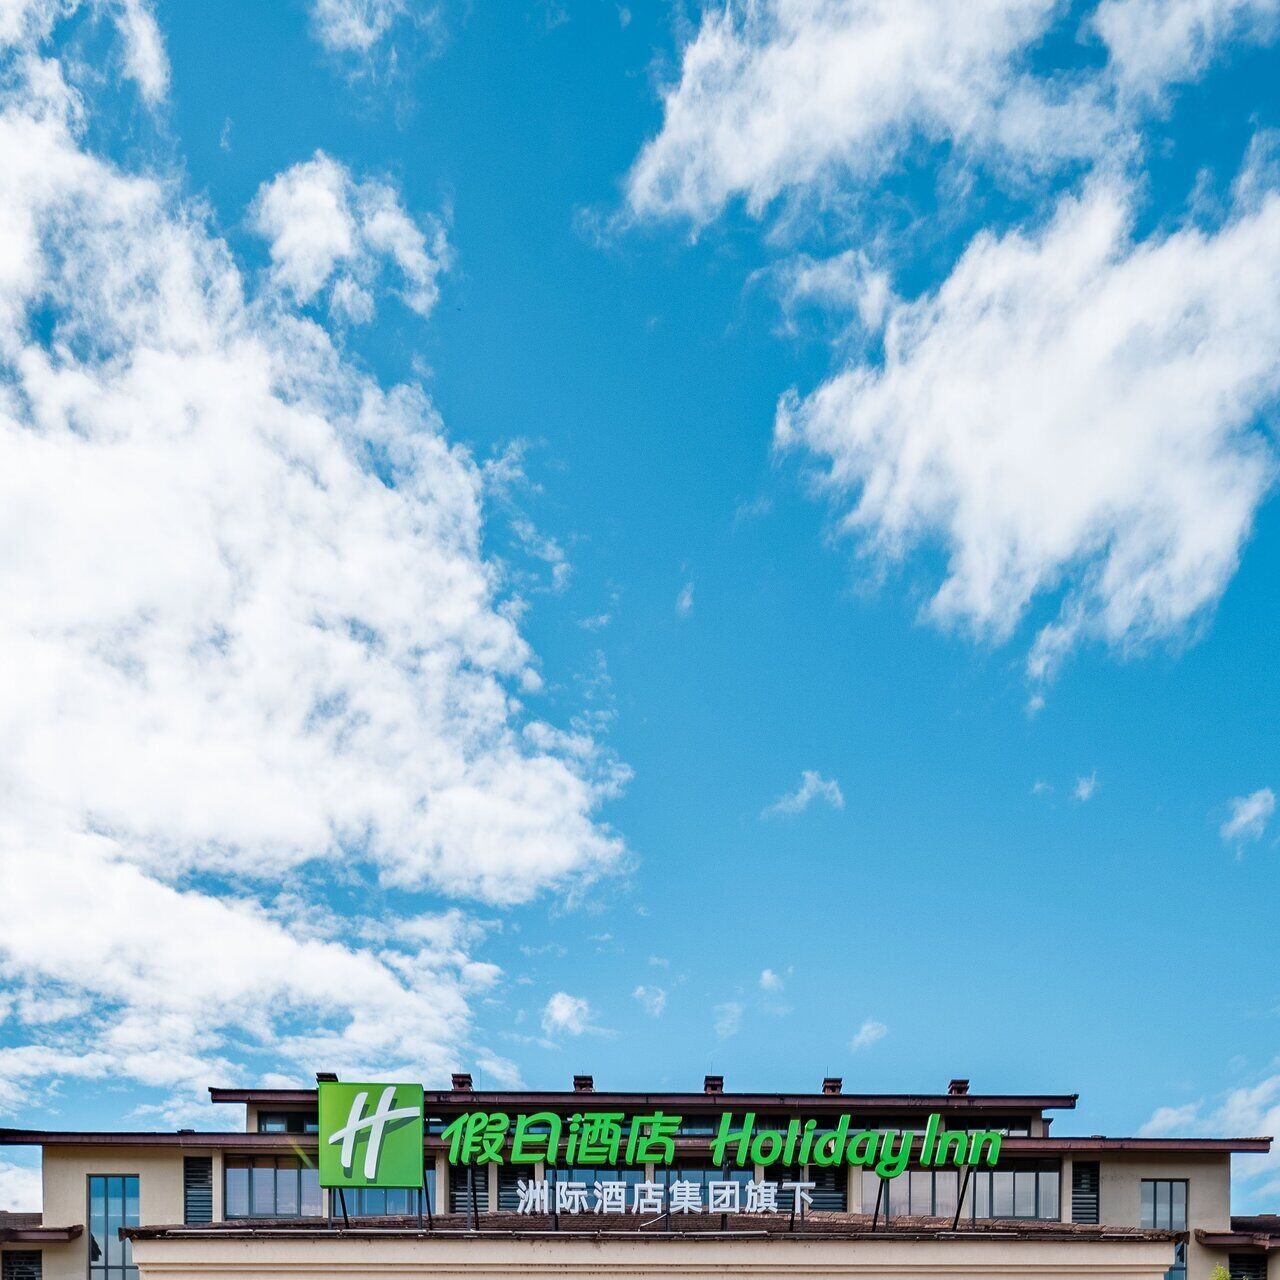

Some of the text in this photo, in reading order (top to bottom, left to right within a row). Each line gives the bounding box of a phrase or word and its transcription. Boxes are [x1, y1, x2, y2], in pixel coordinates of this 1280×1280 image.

[440, 1111, 683, 1166] 假日酒店
[710, 1112, 1004, 1180] Holiday Inn
[516, 1179, 817, 1215] 洲际酒店集团旗下
